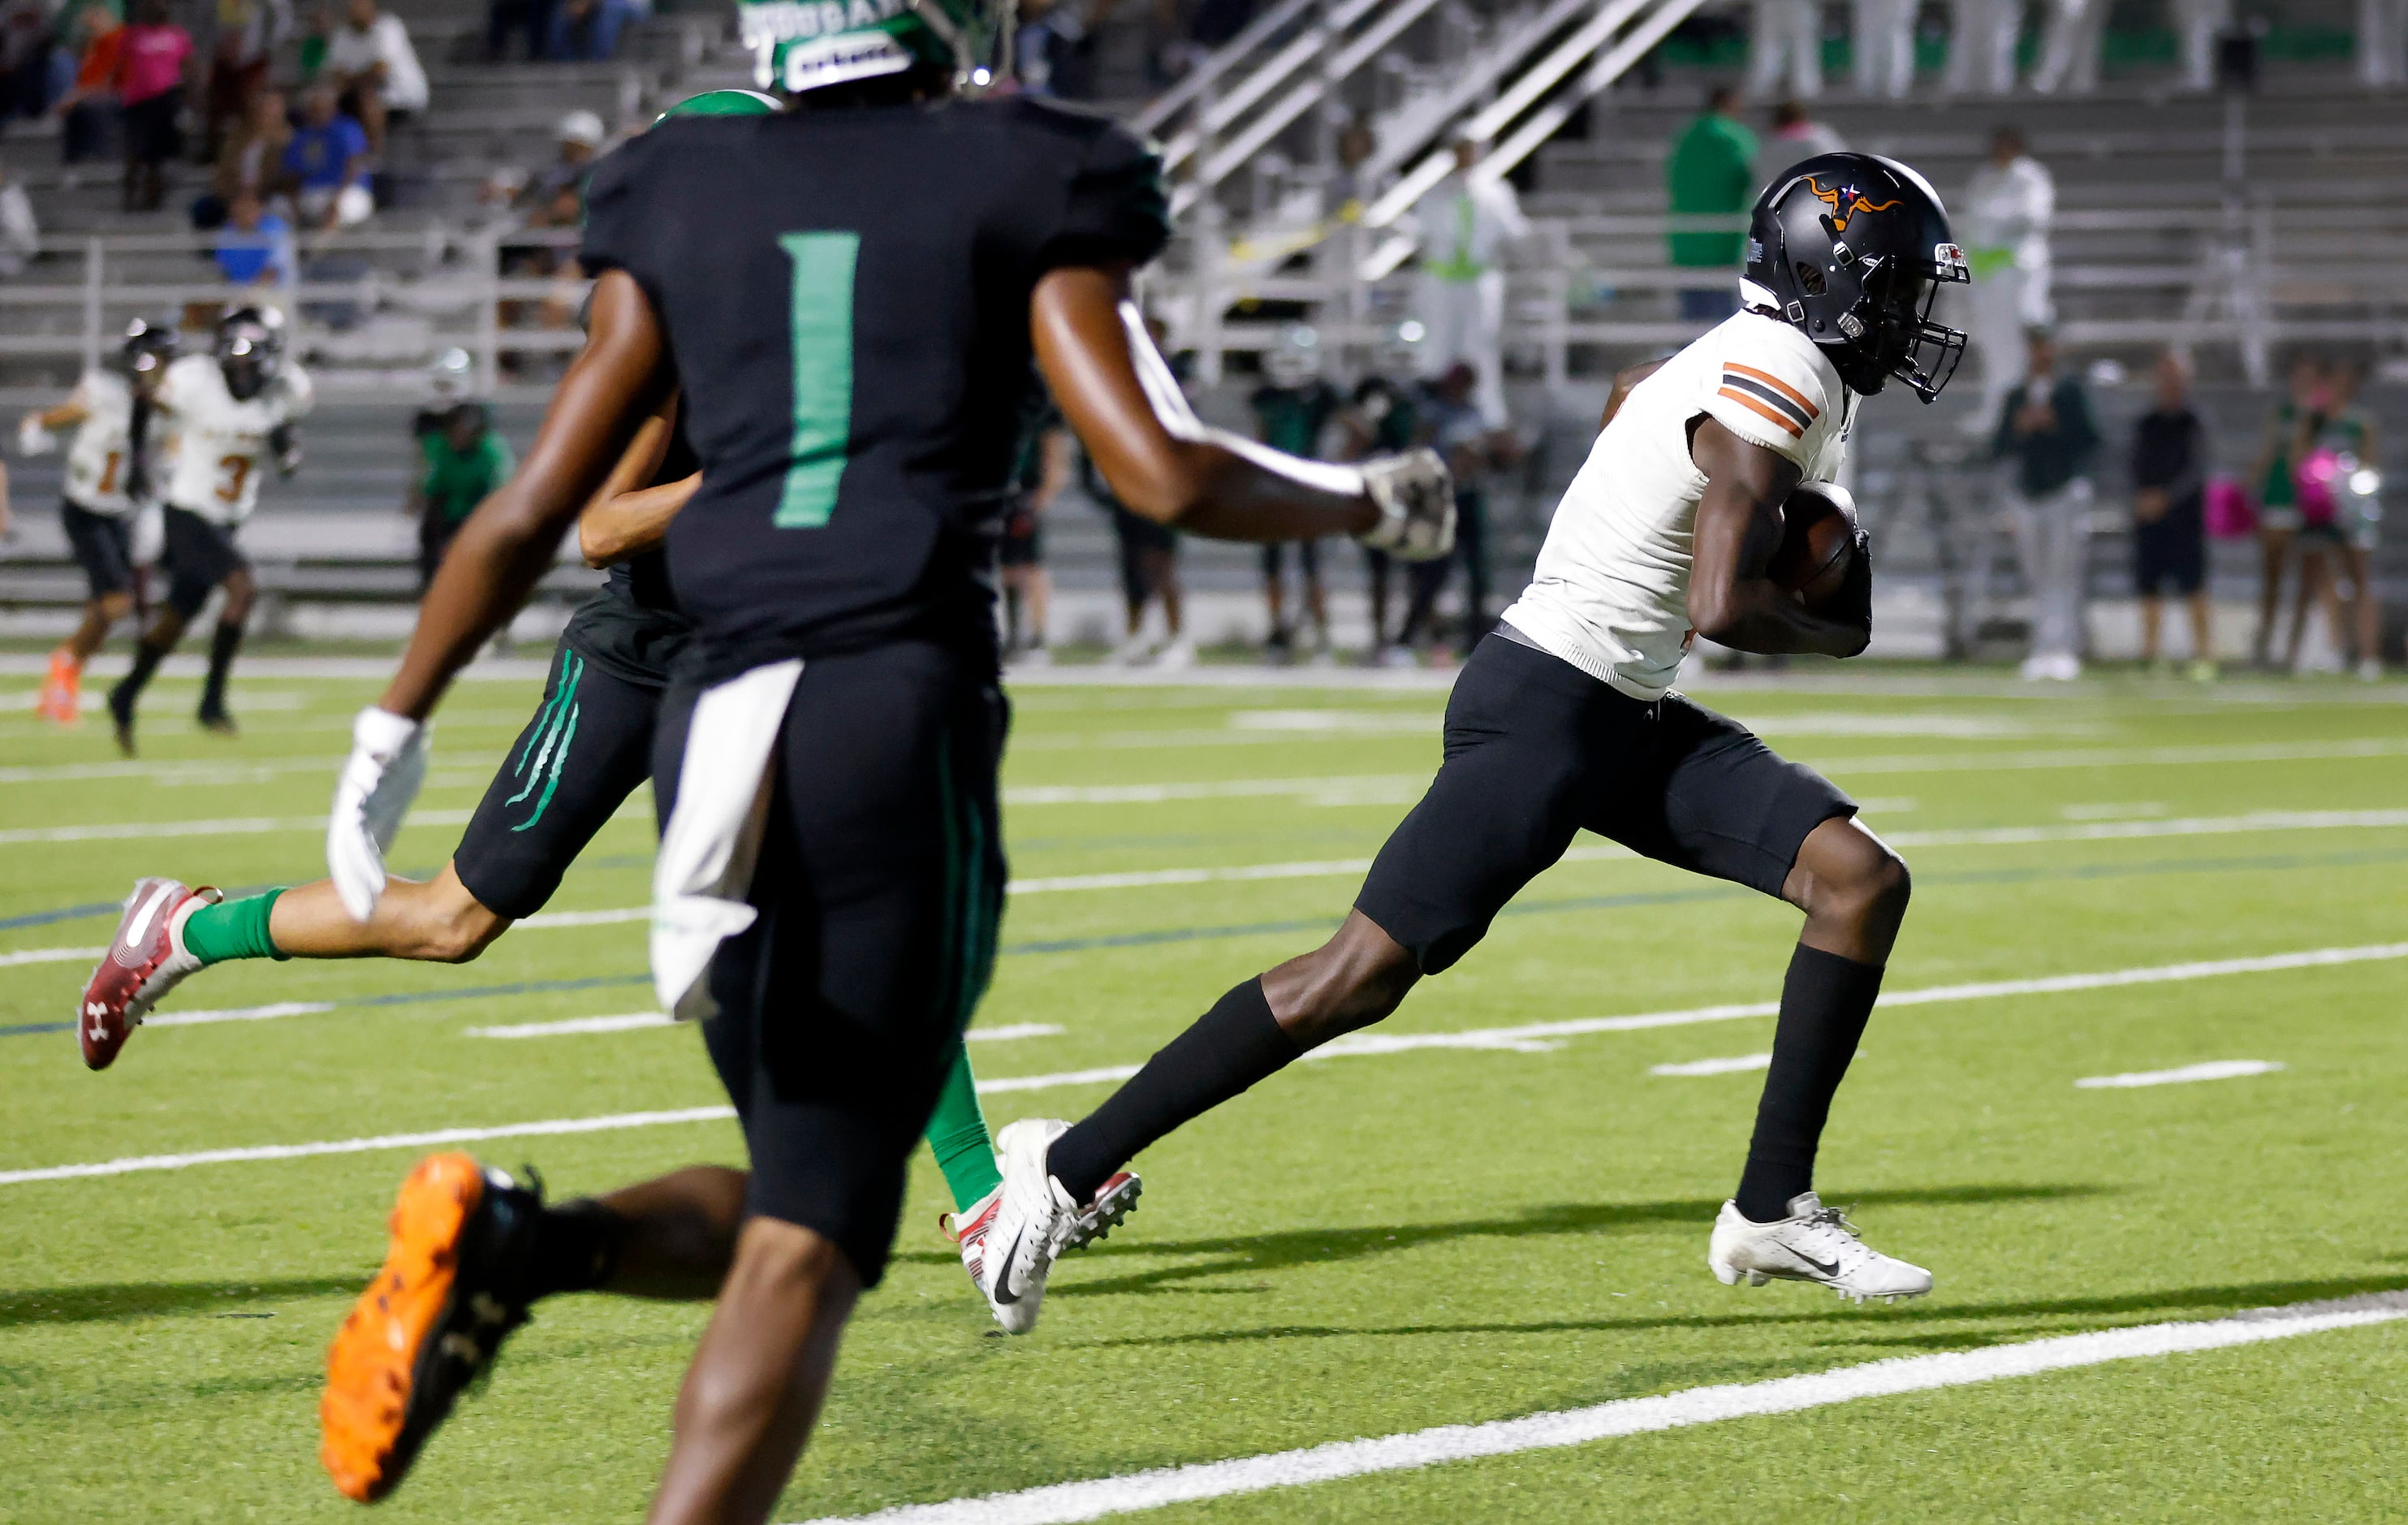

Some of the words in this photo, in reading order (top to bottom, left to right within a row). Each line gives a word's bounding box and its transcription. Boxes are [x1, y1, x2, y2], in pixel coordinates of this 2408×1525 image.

[772, 231, 861, 529] 1
[97, 451, 120, 496] 1
[214, 454, 251, 504] 3
